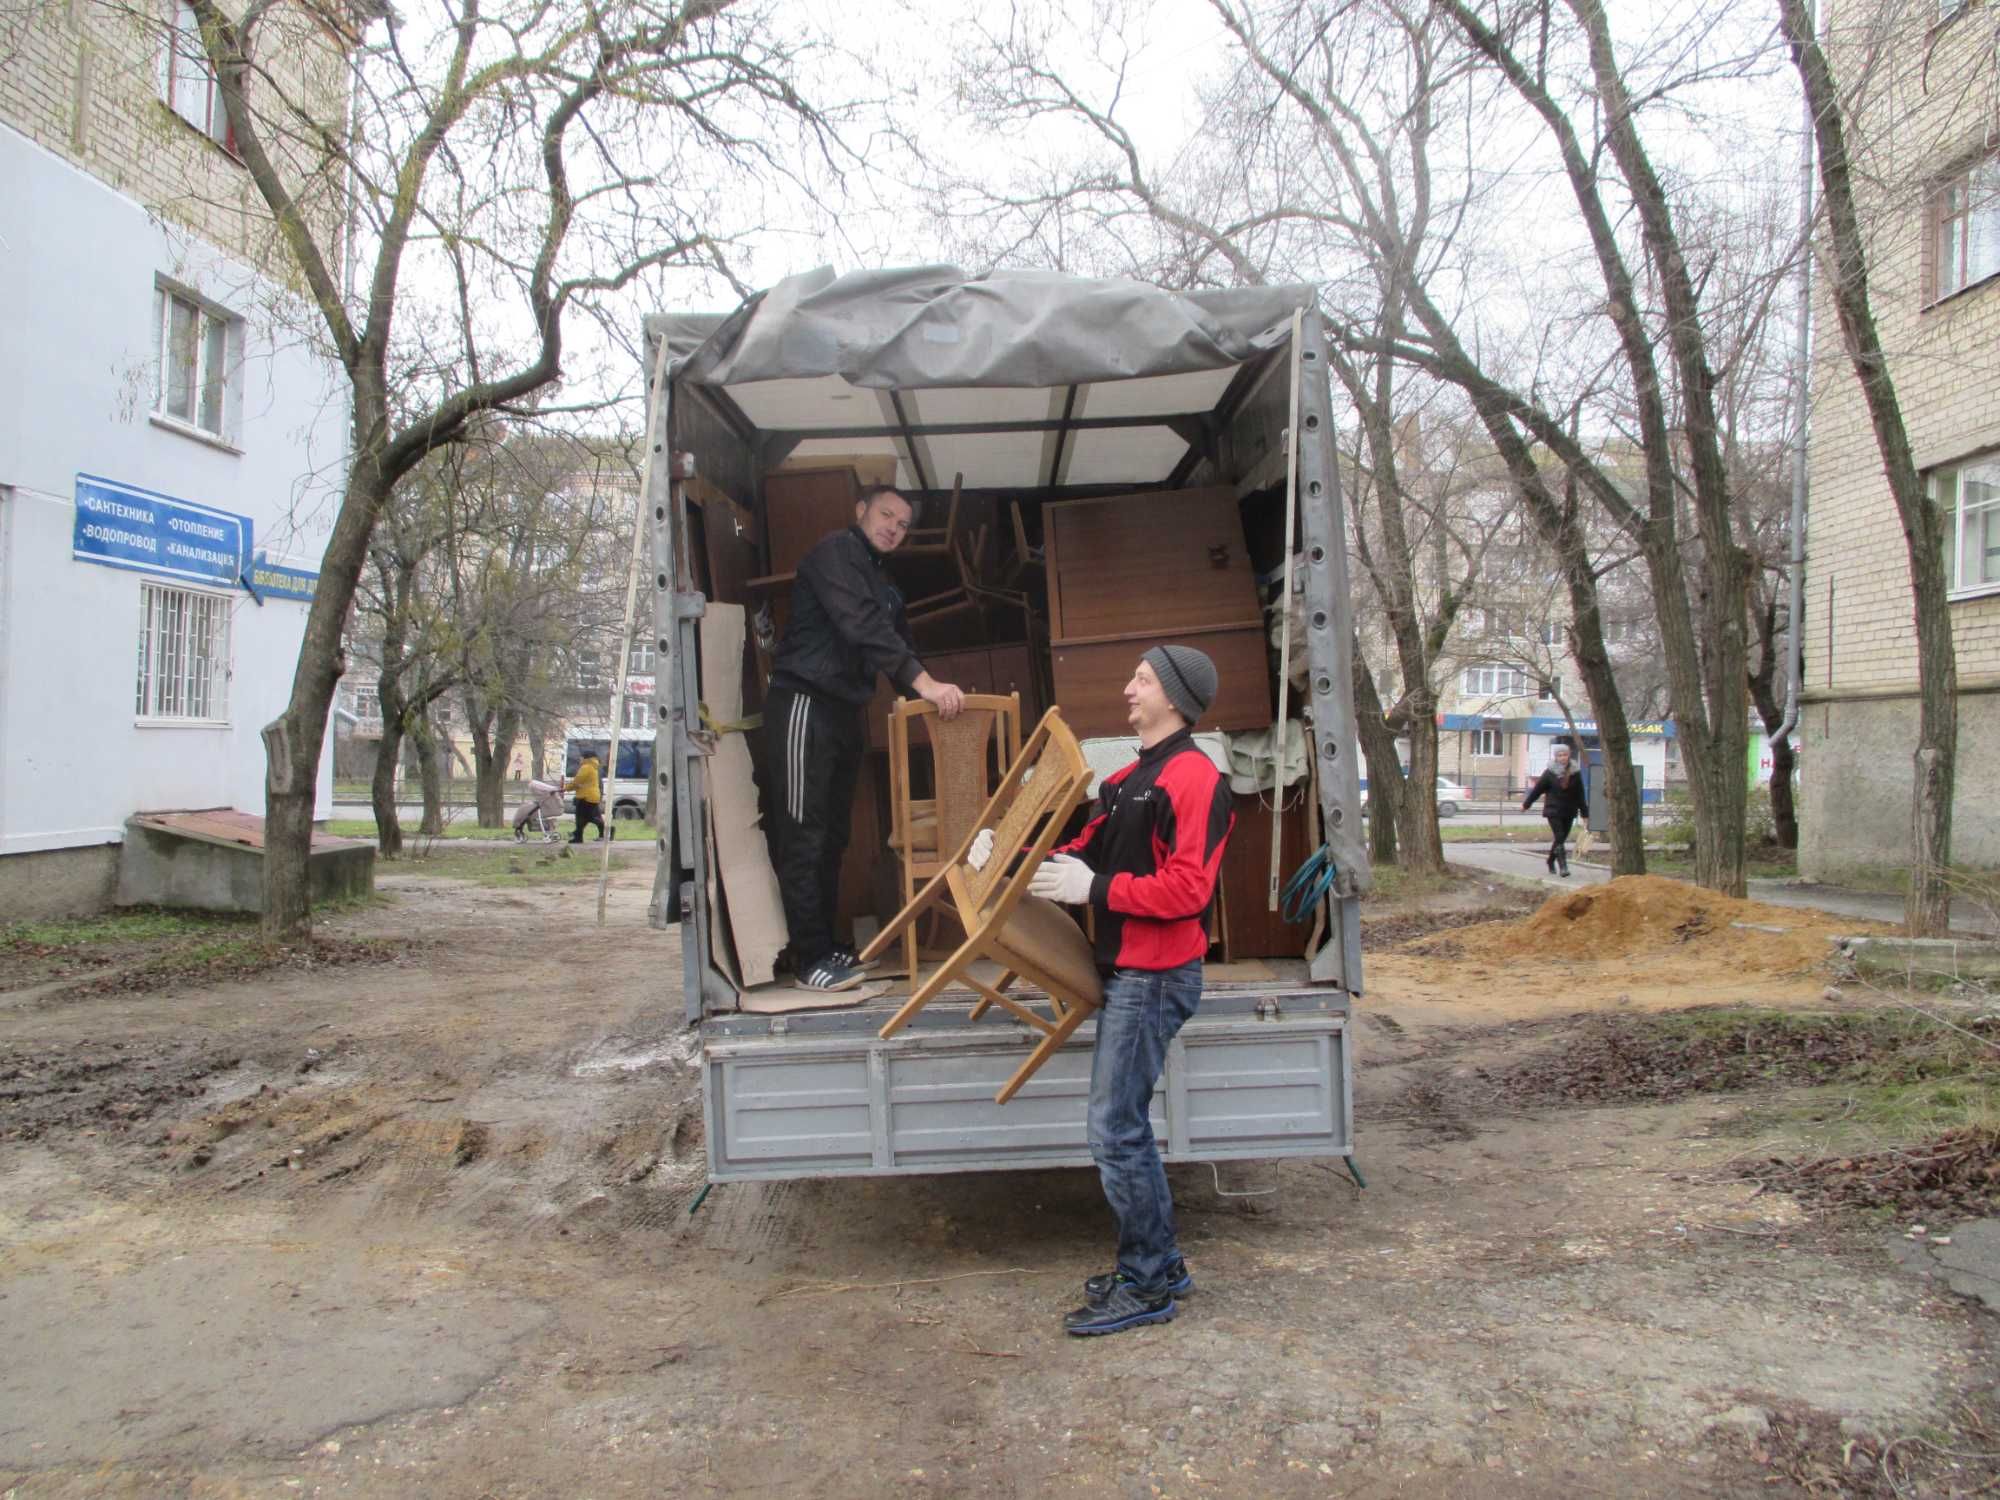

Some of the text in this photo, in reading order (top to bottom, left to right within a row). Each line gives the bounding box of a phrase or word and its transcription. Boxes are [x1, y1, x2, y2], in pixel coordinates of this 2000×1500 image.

[88, 497, 155, 525] САНТЕХНИКА
[86, 525, 157, 553] ВОДОПРОВОД
[172, 518, 225, 542] ОТОПЛЕНИЕ
